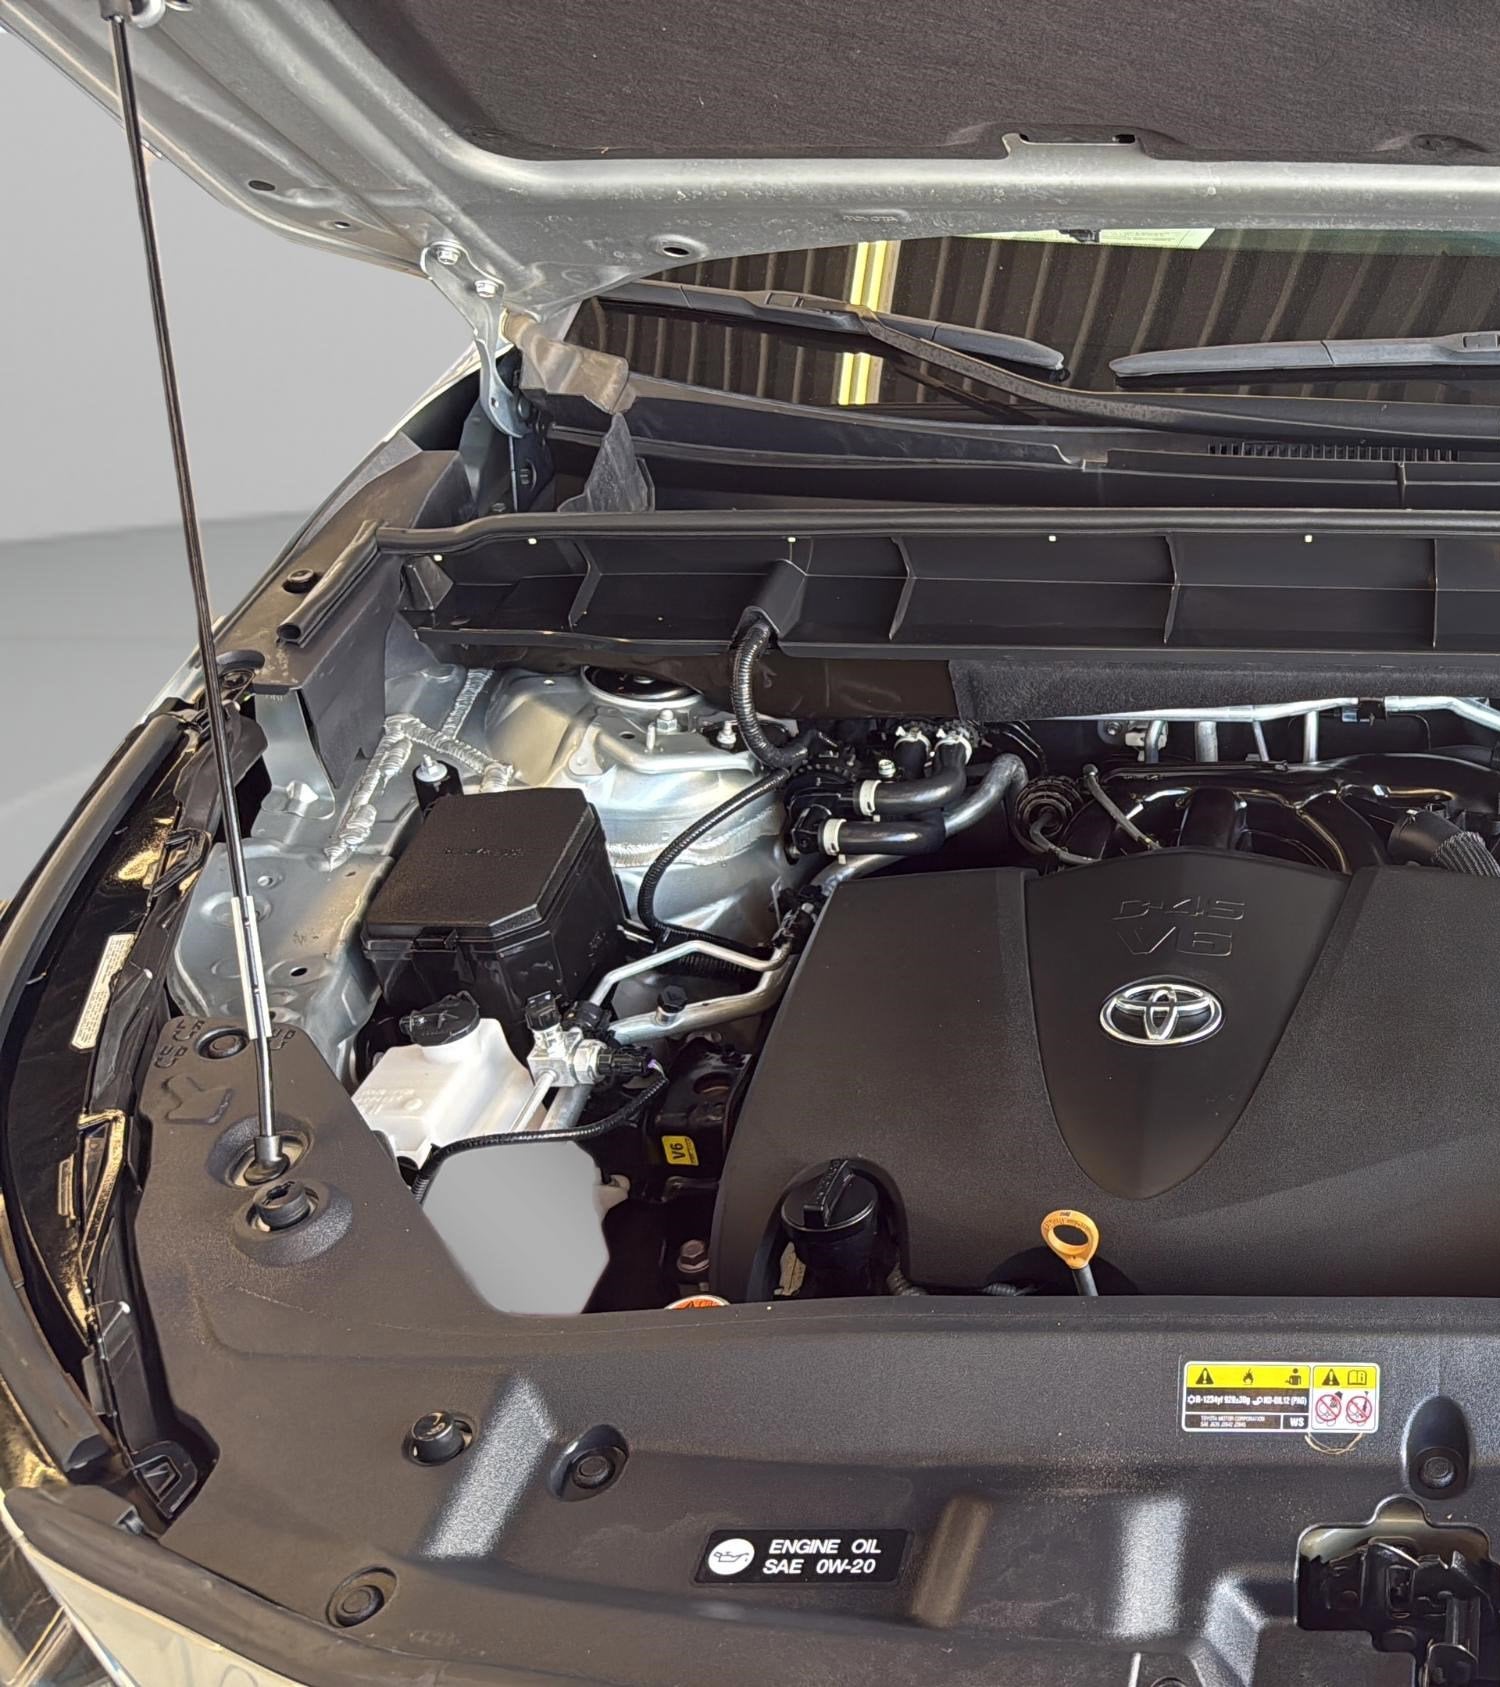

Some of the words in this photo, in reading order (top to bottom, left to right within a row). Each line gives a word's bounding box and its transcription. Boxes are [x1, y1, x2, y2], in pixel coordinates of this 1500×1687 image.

[1115, 925, 1234, 957] V6
[670, 1143, 685, 1159] V6
[1290, 1417, 1305, 1427] WS
[768, 1538, 841, 1554] ENGINE
[851, 1538, 882, 1554] OIL
[762, 1559, 805, 1574] SAE
[815, 1558, 876, 1574] 0W-20
